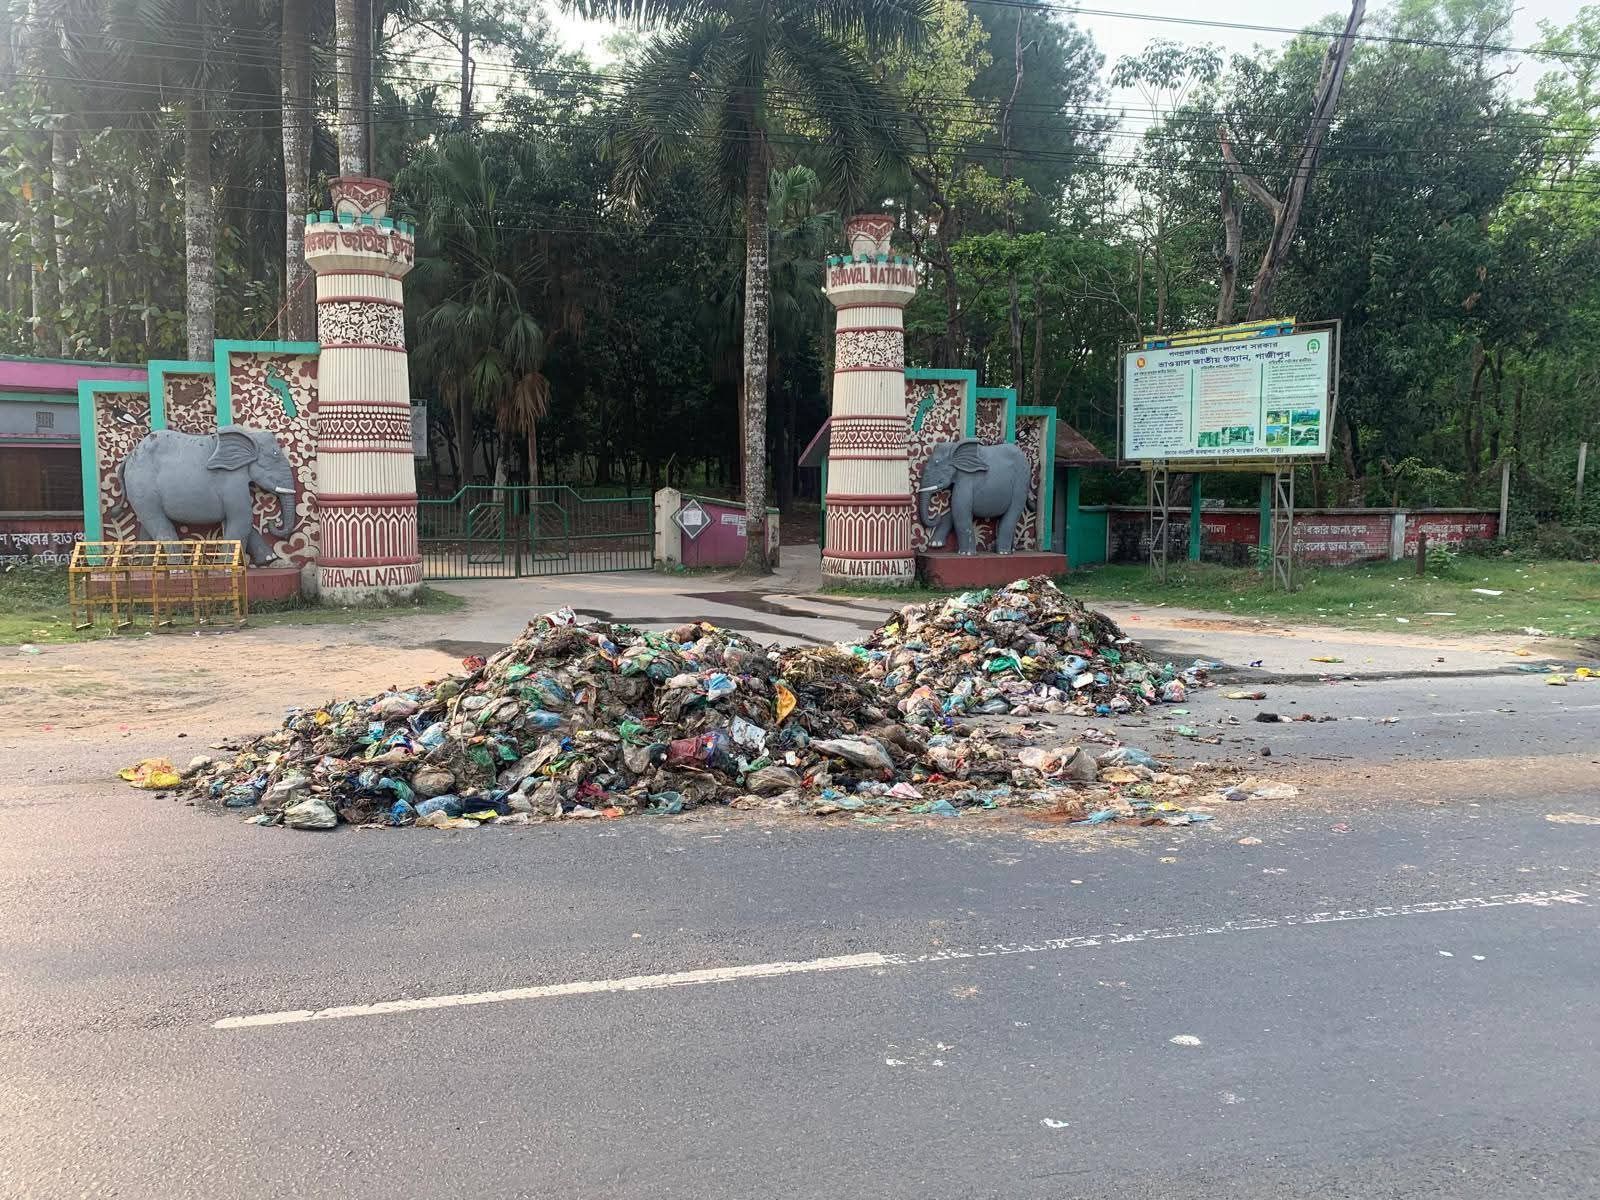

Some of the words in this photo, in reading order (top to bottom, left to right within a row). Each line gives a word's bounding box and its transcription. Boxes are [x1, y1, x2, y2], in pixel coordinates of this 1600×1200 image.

[341, 227, 388, 255] জাতীয়
[831, 267, 868, 287] BHAWAL
[870, 267, 915, 287] NATIONAL
[1210, 344, 1248, 354] বাংলাদেশ
[1250, 341, 1278, 350] সরকার
[1158, 359, 1190, 368] ভাওয়াল
[1193, 356, 1220, 366] জাতীয়
[1223, 354, 1251, 364] উদ্যান,
[1255, 350, 1291, 360] গাজীপুর
[51, 532, 73, 545] হাত
[849, 560, 902, 576] NATIONAL
[321, 568, 375, 588] BHAWAL
